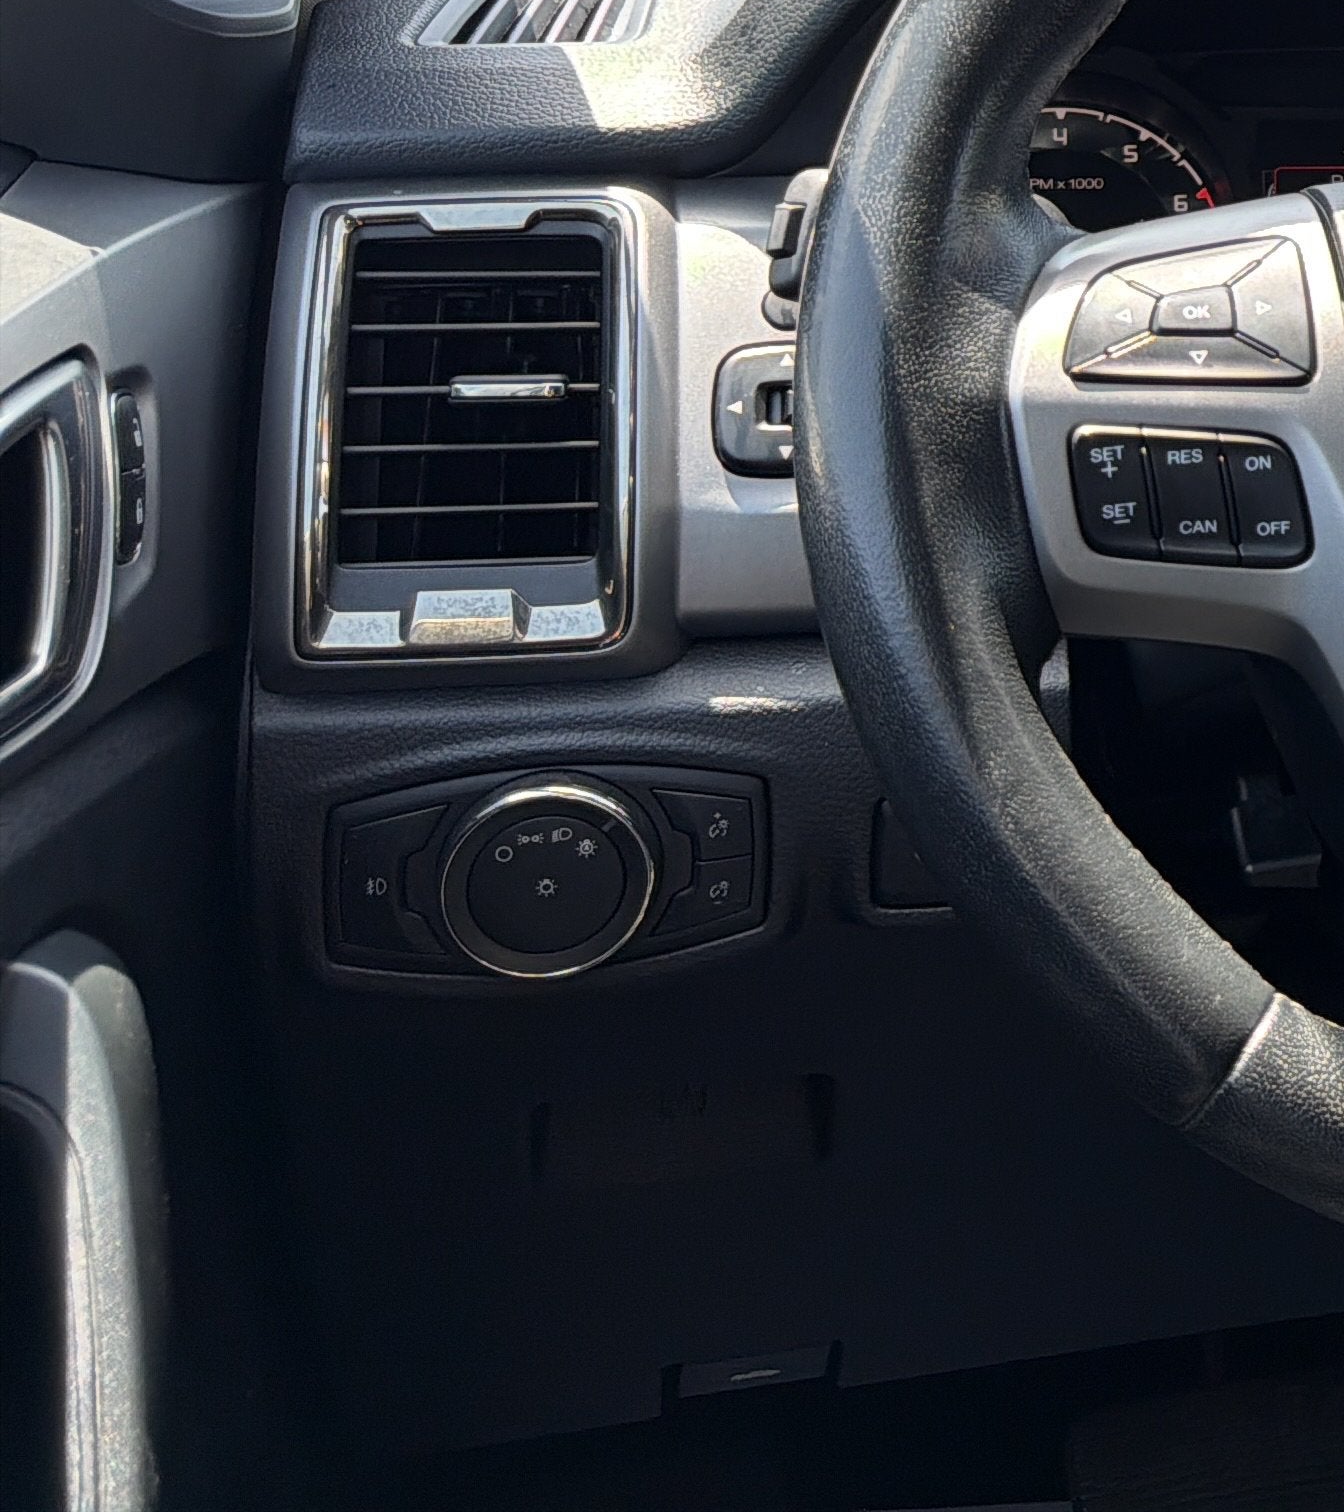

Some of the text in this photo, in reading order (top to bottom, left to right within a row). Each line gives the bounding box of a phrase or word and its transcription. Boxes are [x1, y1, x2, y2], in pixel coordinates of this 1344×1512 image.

[1052, 127, 1068, 146] 4
[1123, 144, 1139, 163] 5
[1030, 178, 1054, 189] PM
[1069, 178, 1104, 190] 1000
[1173, 194, 1189, 213] 6
[1182, 304, 1211, 320] OK
[1090, 445, 1124, 463] SET
[1167, 448, 1203, 466] RES
[1245, 455, 1272, 472] ON
[1102, 501, 1137, 521] SET
[1179, 519, 1218, 536] CAN
[1256, 520, 1291, 536] OFF
